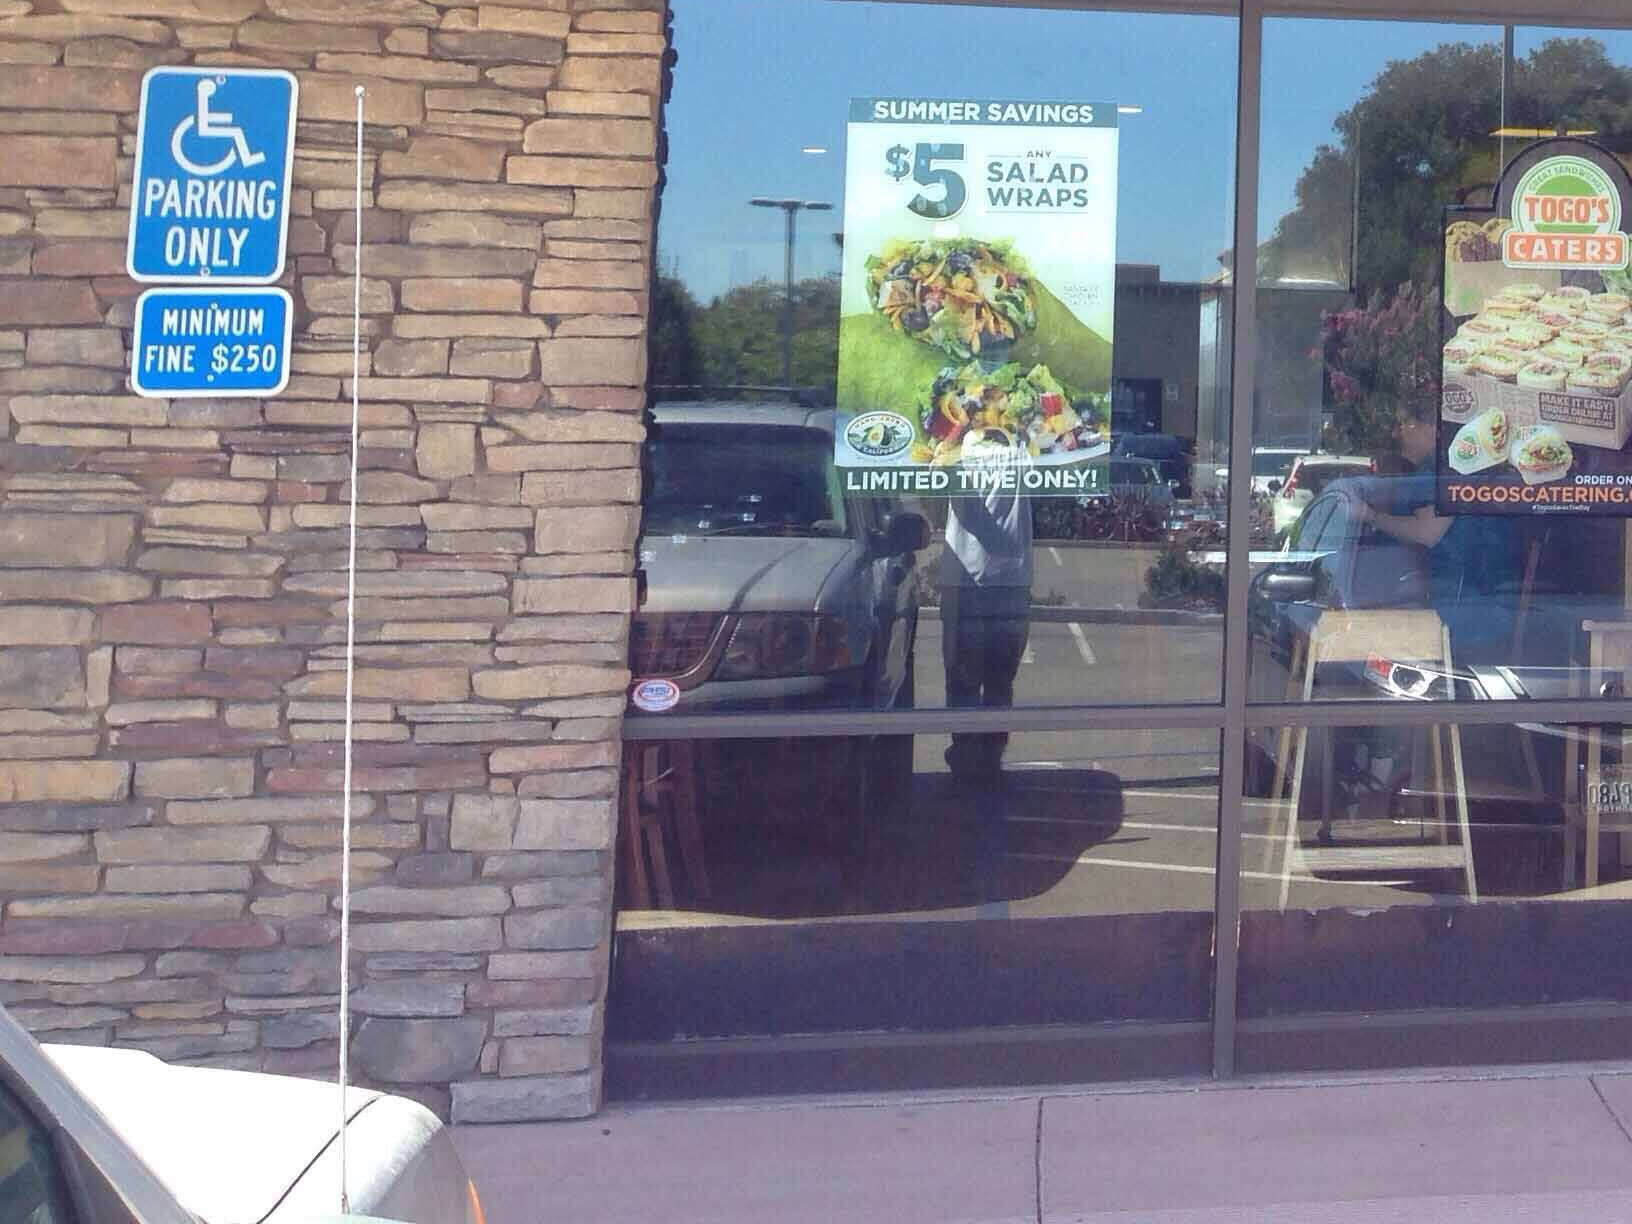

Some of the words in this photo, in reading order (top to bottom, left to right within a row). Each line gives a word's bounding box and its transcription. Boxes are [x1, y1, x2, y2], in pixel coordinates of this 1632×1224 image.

[874, 100, 980, 122] SUMMER
[987, 103, 1093, 124] SAVINGS
[1027, 150, 1051, 158] ANY
[885, 142, 966, 220] $5
[987, 161, 1088, 184] SALAD
[144, 178, 276, 219] PARKING
[987, 187, 1088, 208] WRAPS
[1524, 196, 1610, 223] TOGO'S
[165, 227, 249, 267] ONLY
[1513, 238, 1617, 261] CATERS
[162, 308, 264, 337] MINIMUM
[145, 344, 195, 372] FINE
[211, 343, 277, 373] $250
[1444, 391, 1474, 403] OGO'S
[848, 470, 948, 490] LIMITED
[956, 469, 1017, 490] TIME
[1023, 468, 1097, 490] ONLY!
[1575, 475, 1613, 485] ORDER
